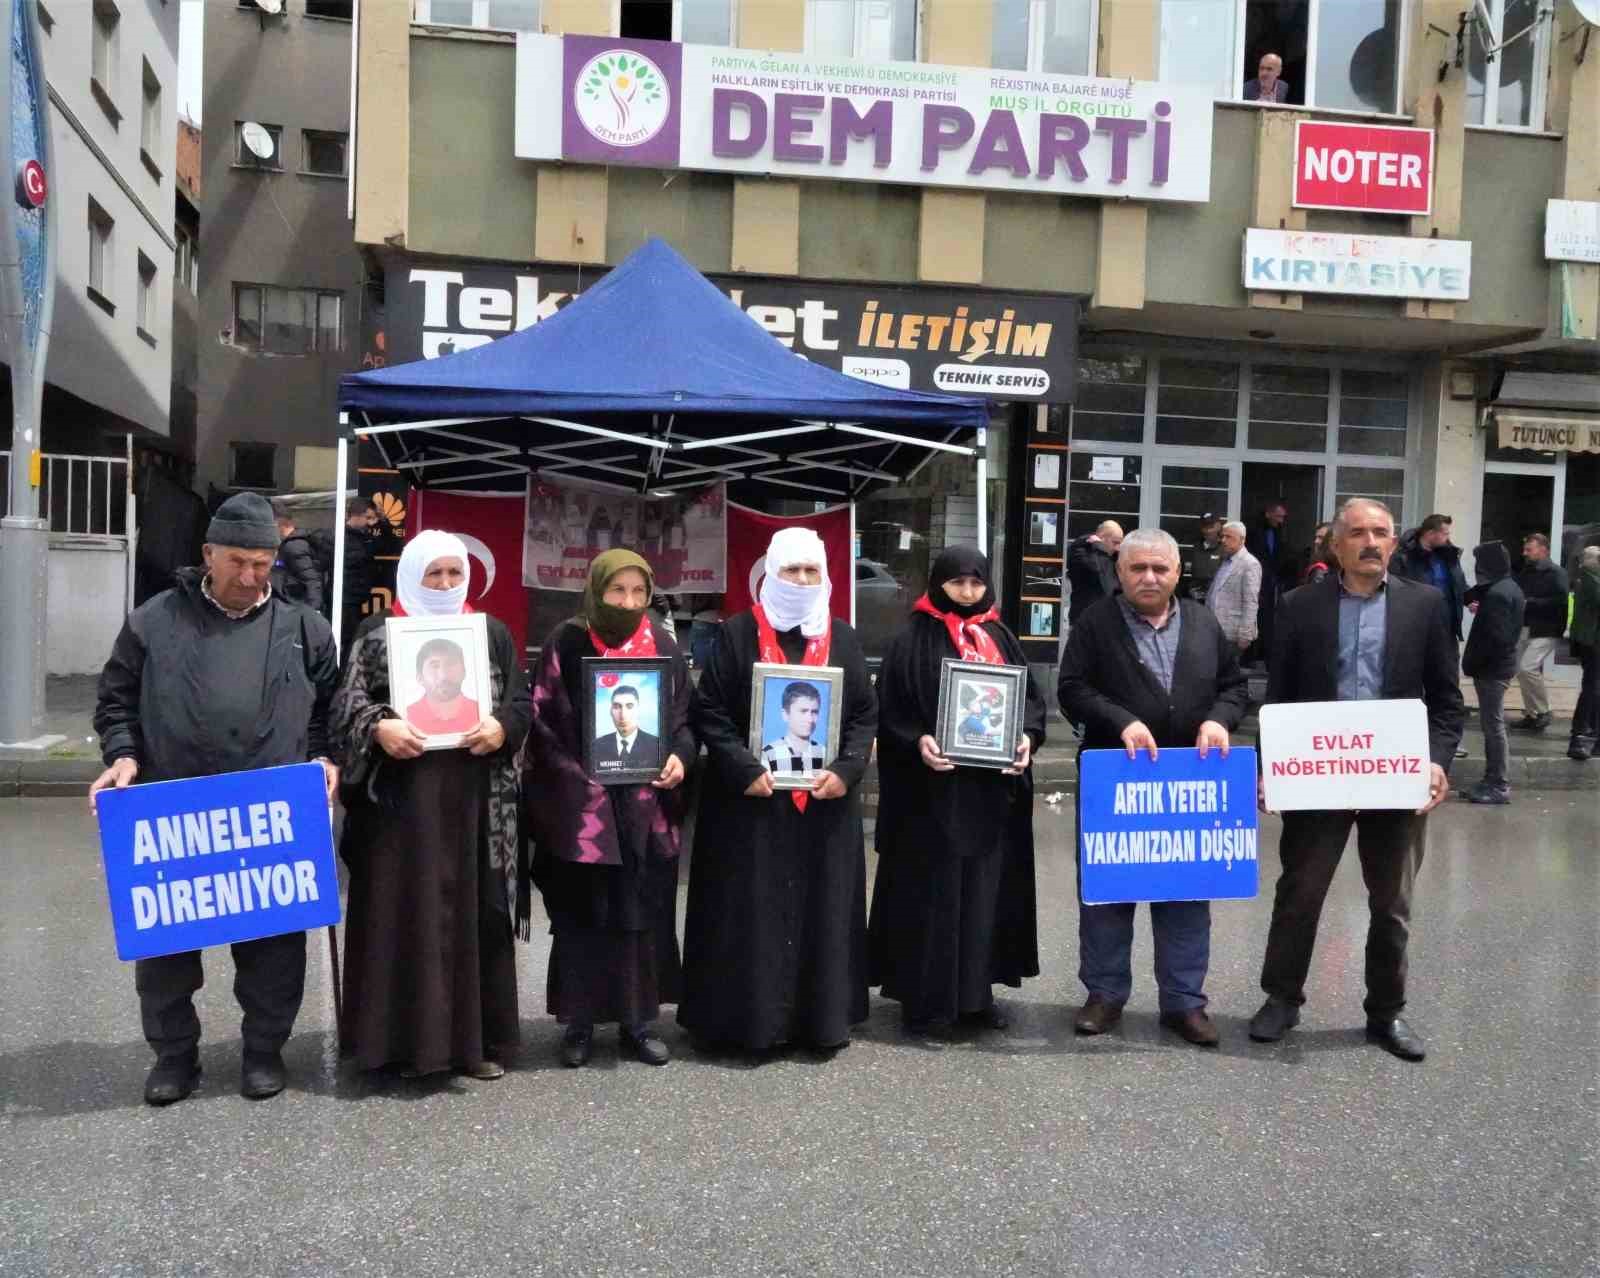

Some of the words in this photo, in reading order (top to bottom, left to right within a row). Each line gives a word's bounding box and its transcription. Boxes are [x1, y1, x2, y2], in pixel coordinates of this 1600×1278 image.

[711, 73, 779, 88] HALKLARIN
[781, 78, 825, 93] EŞİTLİK
[827, 82, 842, 93] VE
[844, 82, 909, 99] DEMOKRASİ
[913, 88, 957, 103] PARTİSİ
[594, 125, 618, 142] DEM
[711, 86, 893, 169] DEM
[920, 100, 1172, 187] PARTİ
[1304, 147, 1422, 189] NOTER
[1251, 255, 1464, 292] KIRTASİYE
[858, 300, 1052, 362] İLETİŞİM
[939, 371, 992, 386] TEKNİK
[995, 373, 1047, 389] SERVİS
[1312, 734, 1374, 751] EVLAT
[1271, 757, 1421, 777] NÖBETİNDEYİZ
[1114, 783, 1163, 816] ARTIK
[1168, 781, 1217, 814] YETER
[1221, 781, 1229, 812] !
[133, 800, 295, 866] ANNELER
[1083, 830, 1196, 865] YAKAMIZDAN
[1200, 820, 1258, 871] DÜŞÜN
[130, 857, 320, 931] DİRENİYOR
